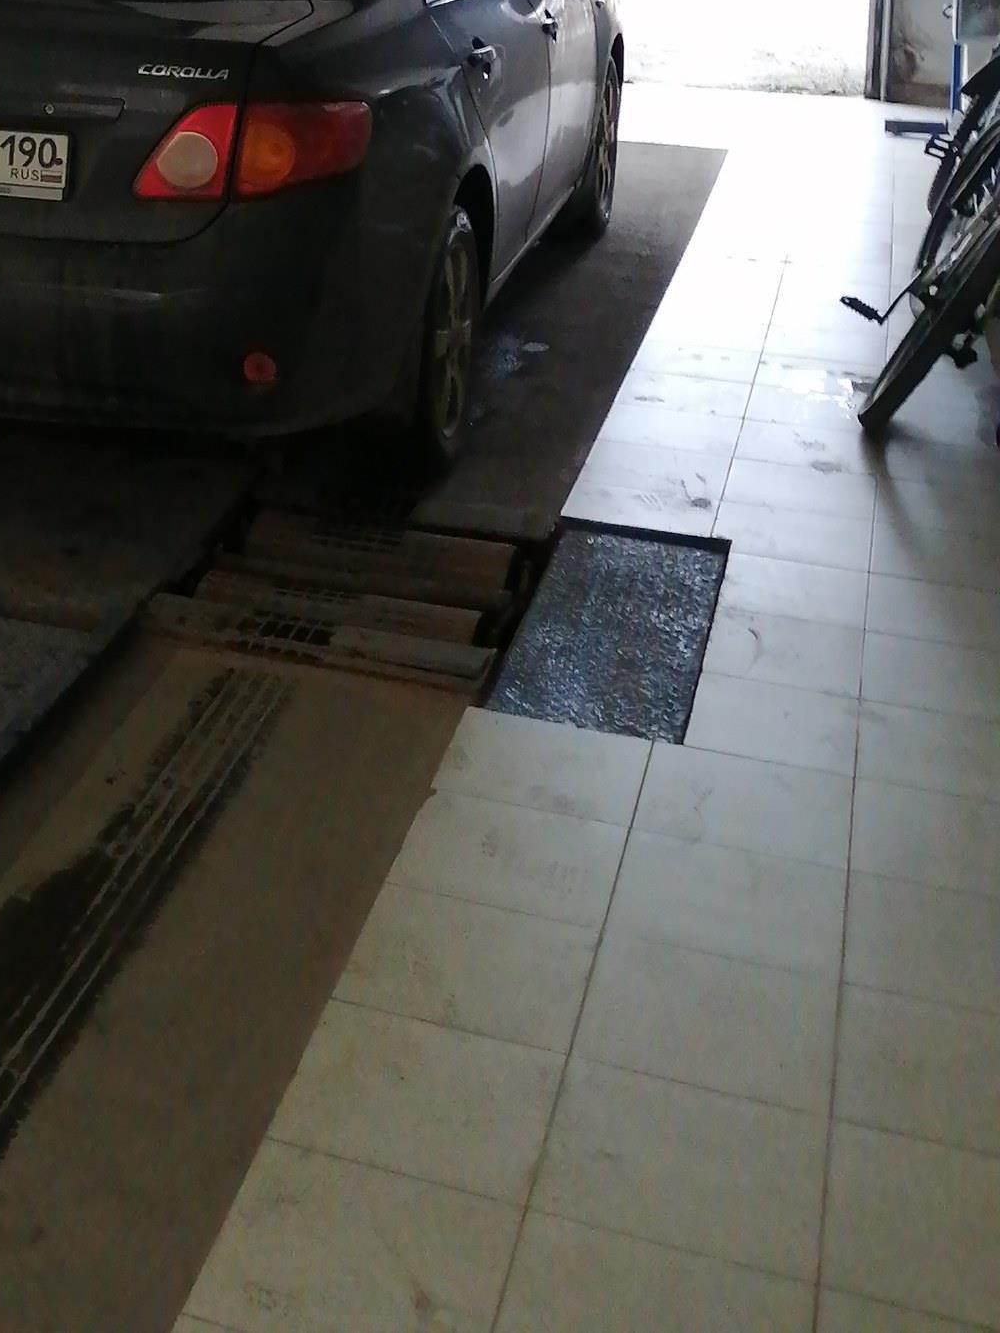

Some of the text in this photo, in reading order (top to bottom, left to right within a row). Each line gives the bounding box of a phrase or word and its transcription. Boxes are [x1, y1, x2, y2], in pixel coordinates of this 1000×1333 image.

[138, 64, 229, 80] COROLLA
[0, 134, 57, 169] 190
[10, 169, 40, 181] RUS
